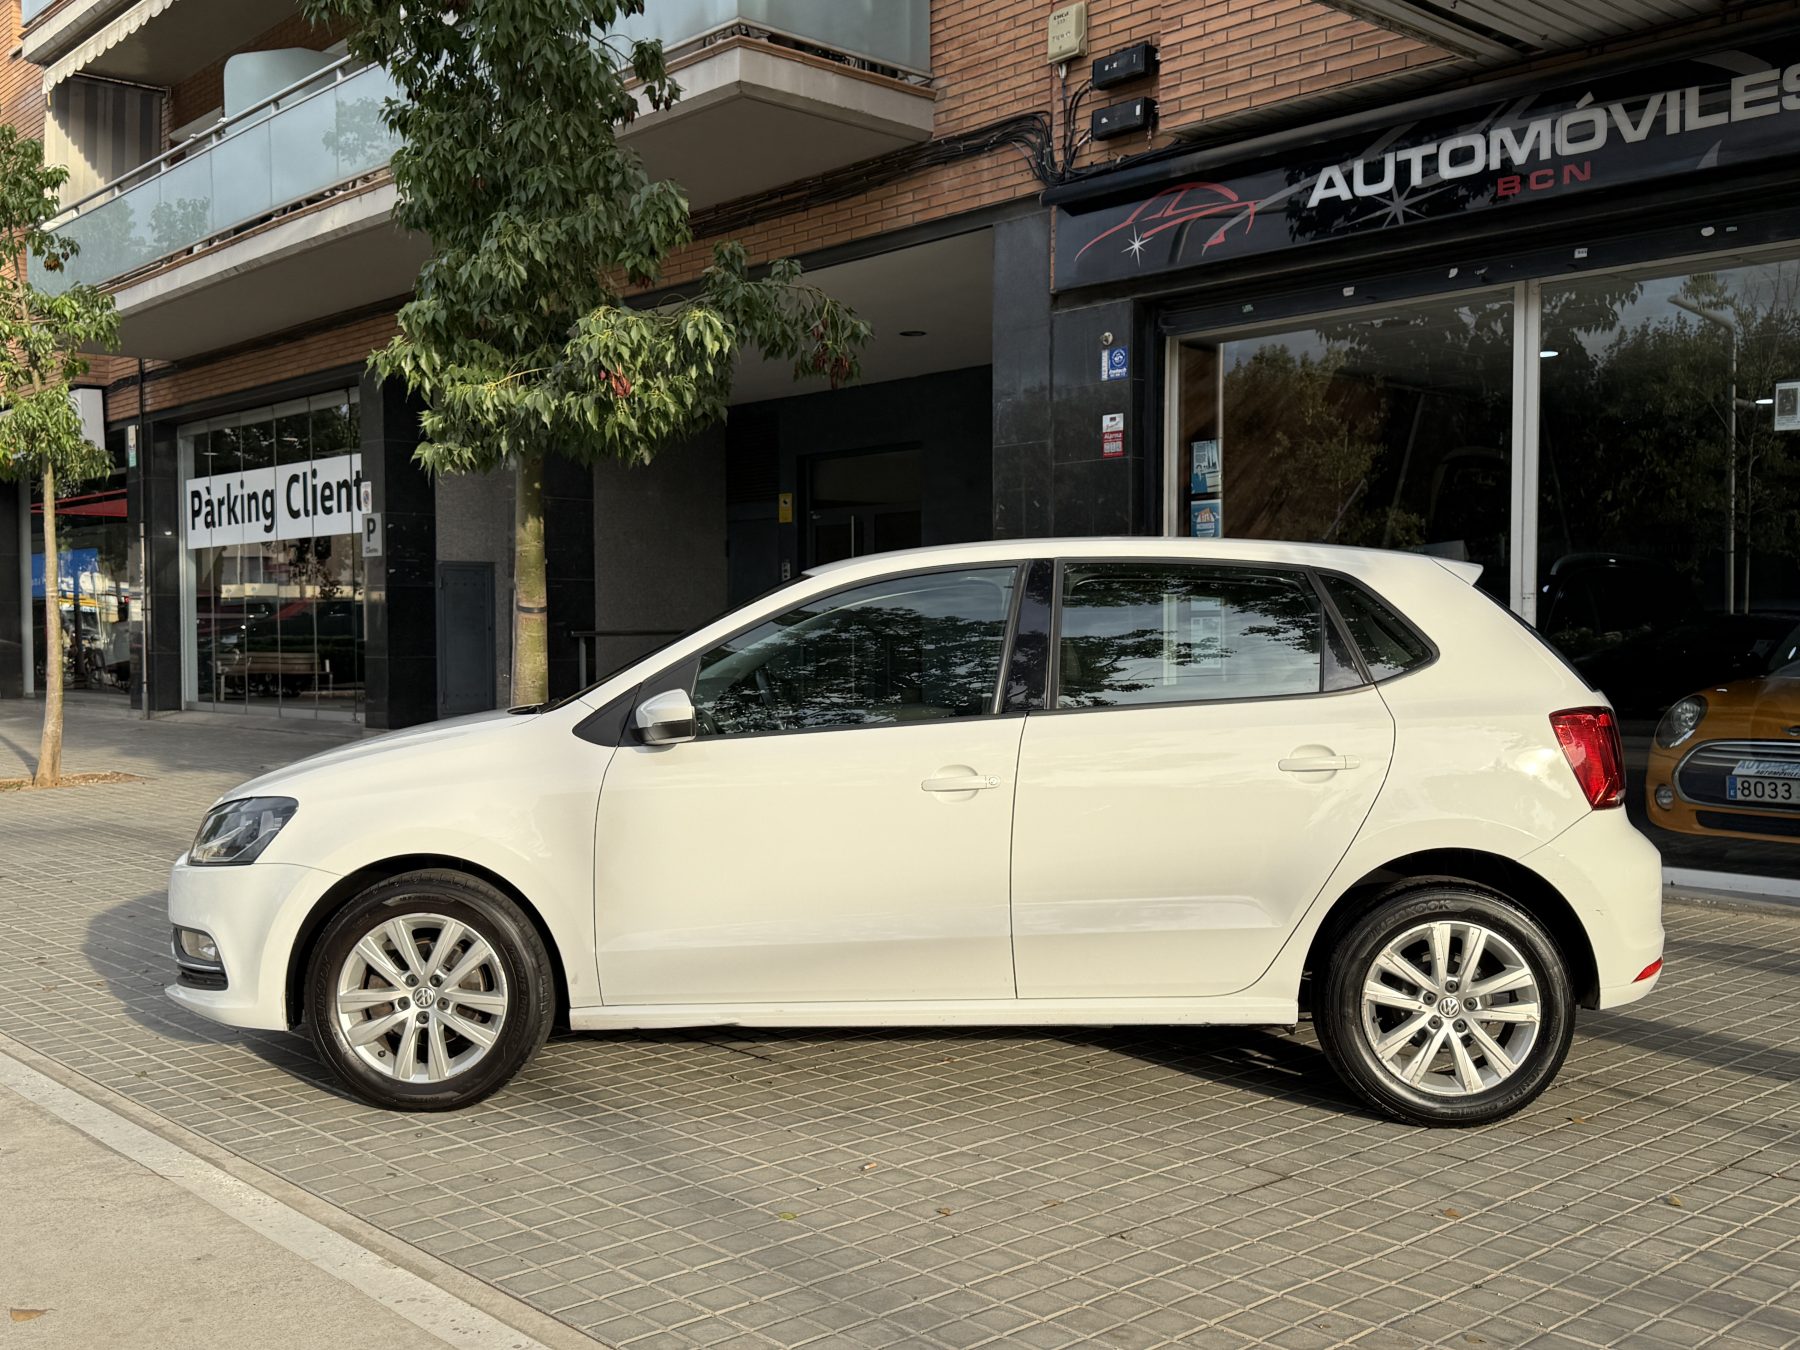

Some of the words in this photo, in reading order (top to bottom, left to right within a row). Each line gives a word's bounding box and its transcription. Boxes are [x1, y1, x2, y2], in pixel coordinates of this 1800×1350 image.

[1497, 160, 1591, 197] BCN
[190, 480, 276, 534] Pàrking
[366, 518, 376, 542] P
[1740, 780, 1793, 800] 8033
